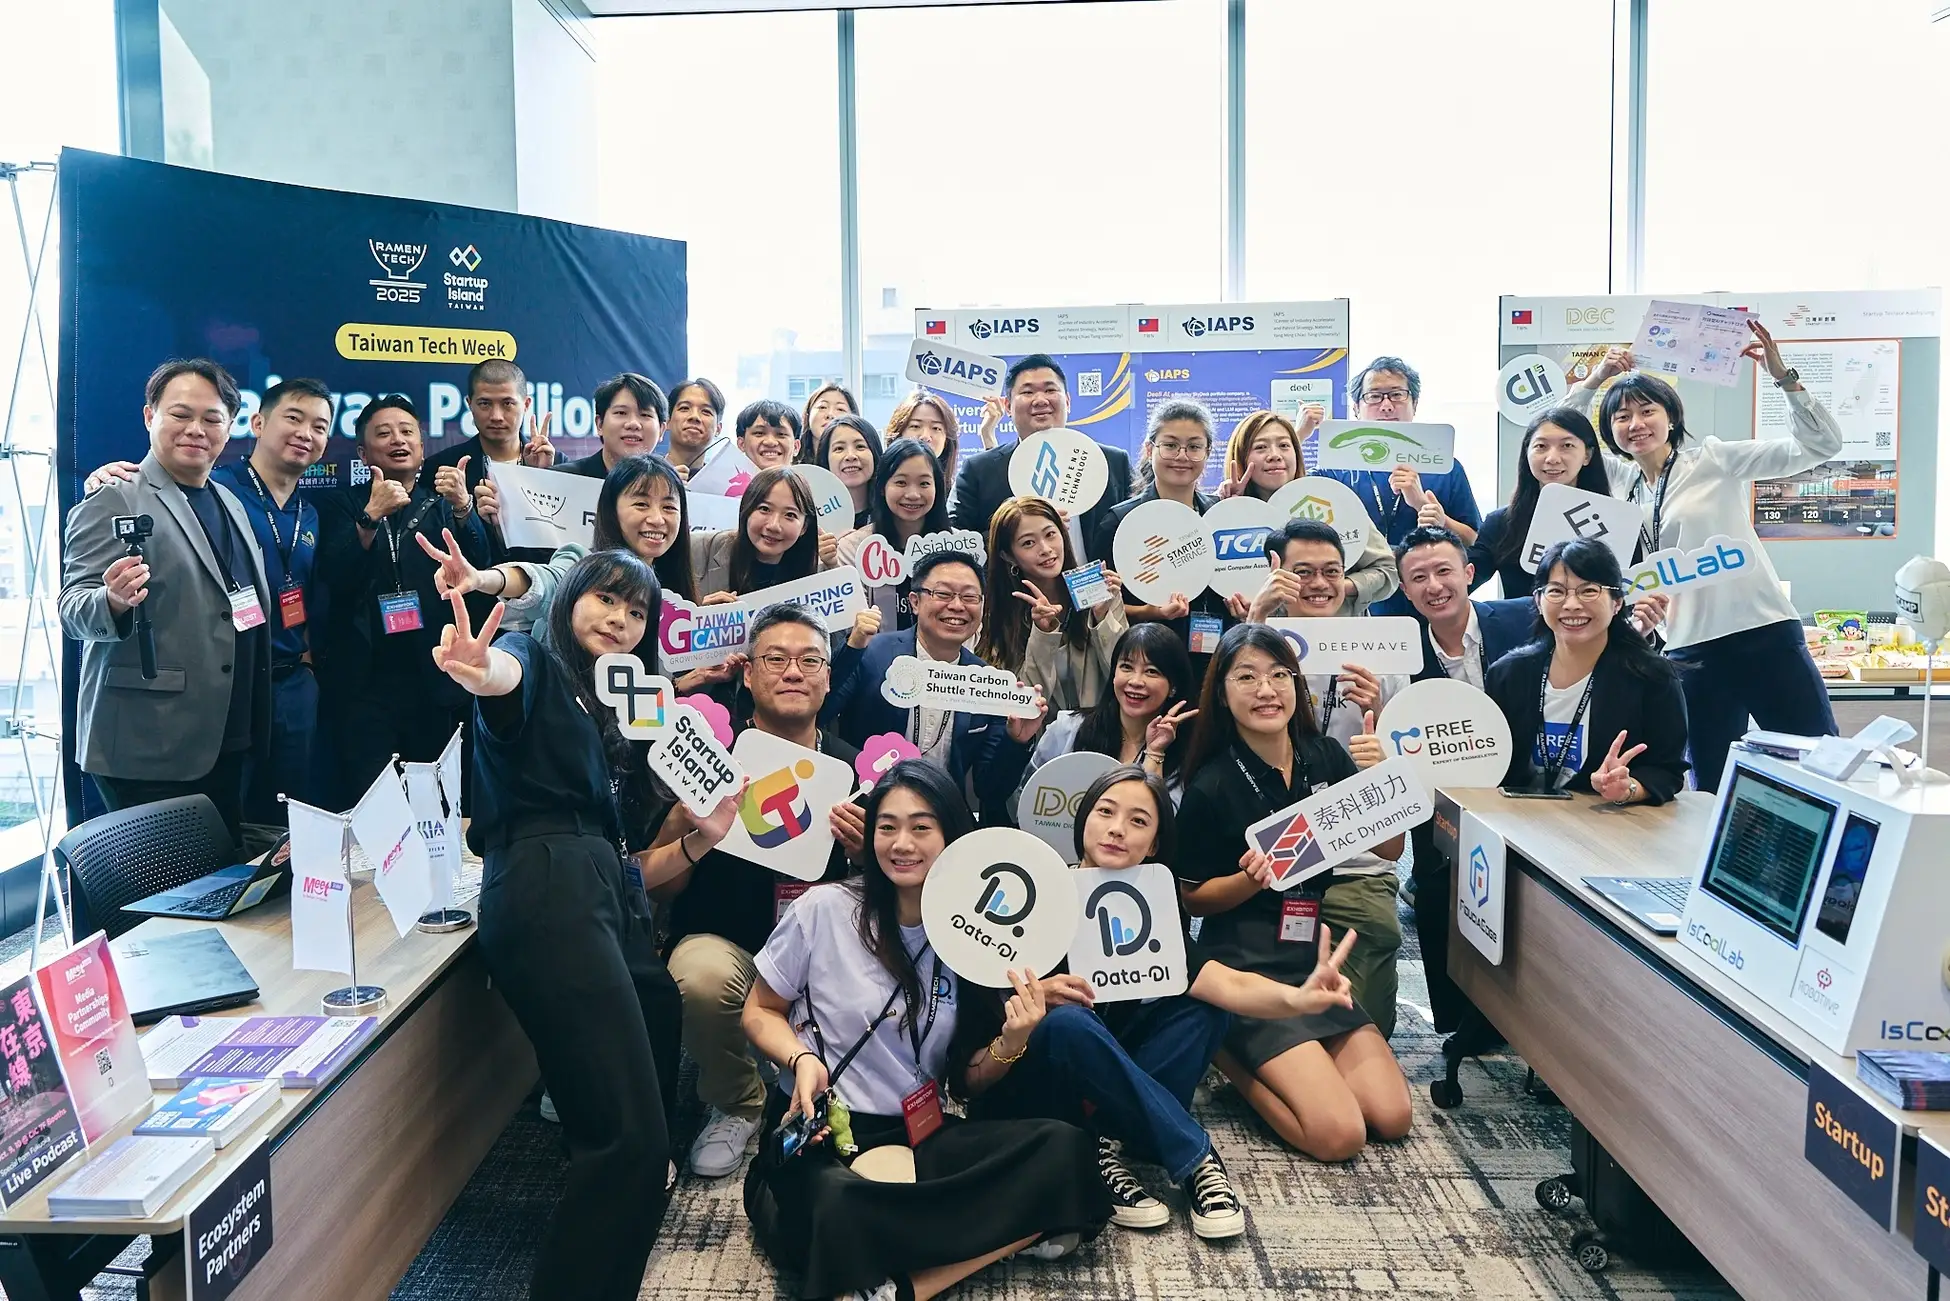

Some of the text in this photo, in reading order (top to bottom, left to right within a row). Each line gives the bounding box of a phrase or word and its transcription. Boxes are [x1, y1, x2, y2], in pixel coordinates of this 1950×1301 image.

[376, 241, 421, 254] RAMEN
[382, 253, 415, 265] TECH
[443, 271, 489, 289] Startup
[376, 287, 421, 303] 2025
[448, 287, 484, 302] Island
[448, 302, 485, 311] TAIWAN
[1566, 307, 1616, 325] DGC
[993, 318, 1040, 334] IAPS
[1207, 316, 1255, 332] IAPS
[348, 332, 507, 358] Taiwan Tech Week
[943, 356, 998, 386] IAPS
[1160, 369, 1190, 379] IAPS
[1395, 452, 1444, 465] ENSE
[1059, 447, 1081, 502] SHIPENG
[1067, 449, 1089, 504] TECHNOLOGY
[527, 489, 560, 502] RAMEN
[1764, 511, 1781, 519] 130
[1802, 510, 1819, 519] 120
[1843, 510, 1849, 518] 2
[1875, 510, 1882, 518] 8
[911, 536, 977, 557] Asiabots
[1166, 536, 1203, 561] STARTUP
[1219, 532, 1265, 555] TCA
[1171, 544, 1208, 569] TERRACE
[1072, 572, 1099, 586] EXHIBITOR
[695, 610, 745, 630] TAIWAN
[693, 627, 745, 649] CAMP
[1319, 641, 1408, 652] DEEPWAVE
[669, 653, 704, 665] GROWING
[927, 668, 1010, 687] Taiwan Carbon
[926, 682, 966, 696] Shuttle
[968, 687, 1033, 705] Technology
[1424, 719, 1474, 739] FREE
[675, 714, 735, 785] Startup
[1428, 735, 1496, 757] Bionics
[666, 735, 722, 795] Island
[659, 752, 708, 805] TAIWAN
[1313, 773, 1408, 832] 泰科動力
[1035, 820, 1061, 828] TAIWAN
[1328, 802, 1422, 853] TAC Dynamics
[1435, 810, 1458, 843] Startup
[303, 876, 331, 897] Meet
[950, 913, 1018, 962] Data-DI
[1092, 964, 1171, 988] Data-DI
[74, 987, 95, 1005] Media
[67, 993, 109, 1024] Partnerships
[73, 1007, 110, 1035] Community
[906, 1089, 933, 1111] EXHIBITOR
[1814, 1101, 1886, 1181] Startup
[0, 1136, 52, 1177] Special from Fukuoka
[5, 1167, 33, 1194] Live
[31, 1130, 79, 1174] Podcast
[198, 1178, 266, 1261] Ecosystem
[206, 1212, 262, 1285] Partners
